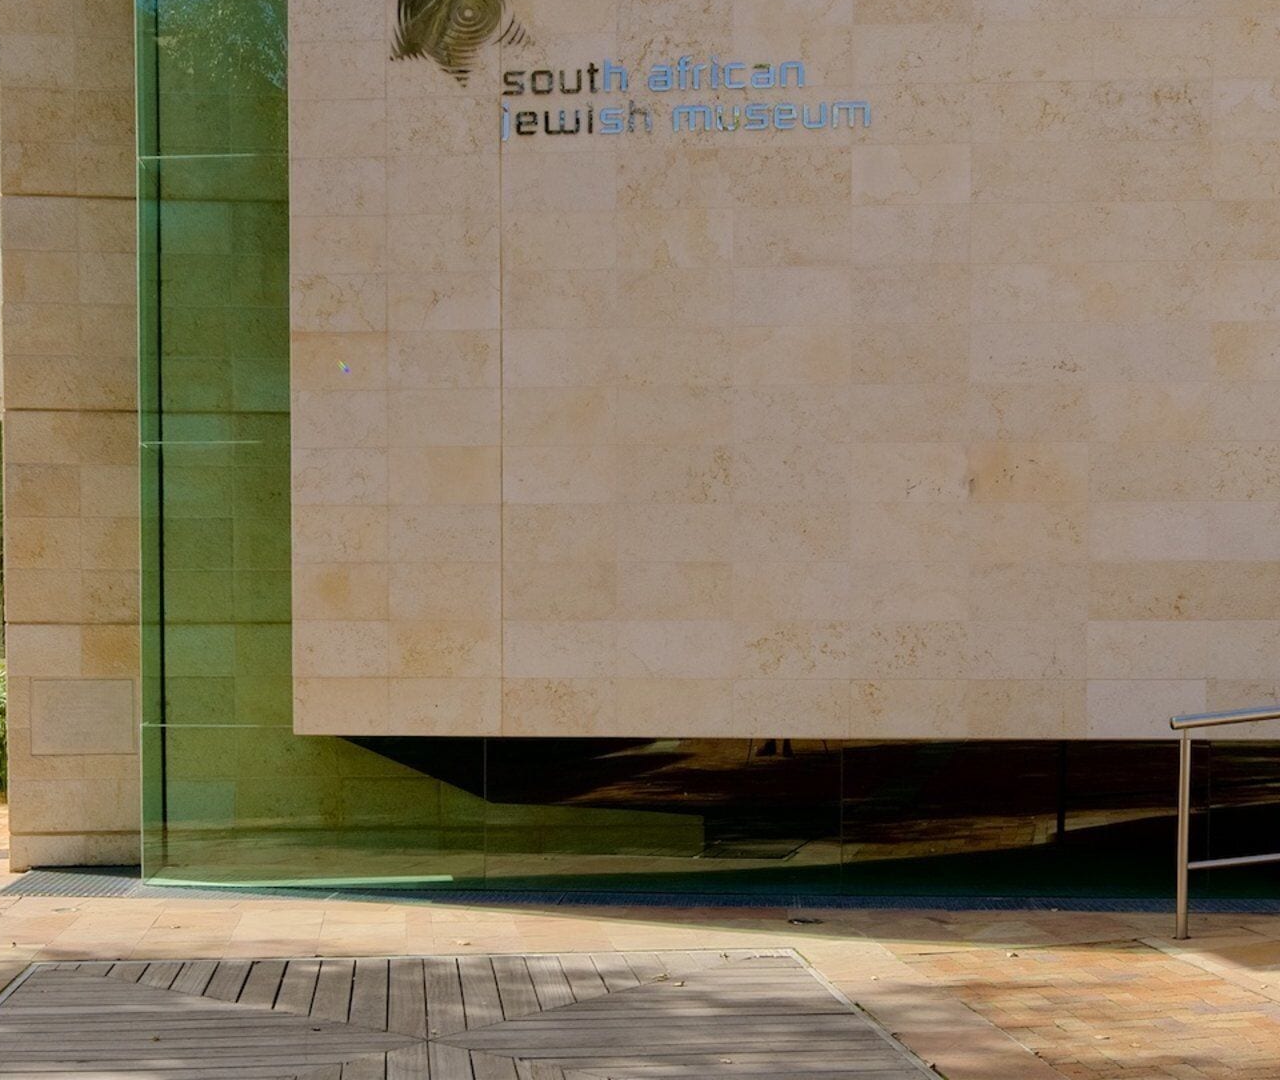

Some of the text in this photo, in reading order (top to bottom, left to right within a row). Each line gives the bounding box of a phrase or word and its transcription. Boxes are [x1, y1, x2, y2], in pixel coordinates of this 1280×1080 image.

[503, 55, 806, 96] south african
[501, 99, 872, 142] jewish museum
